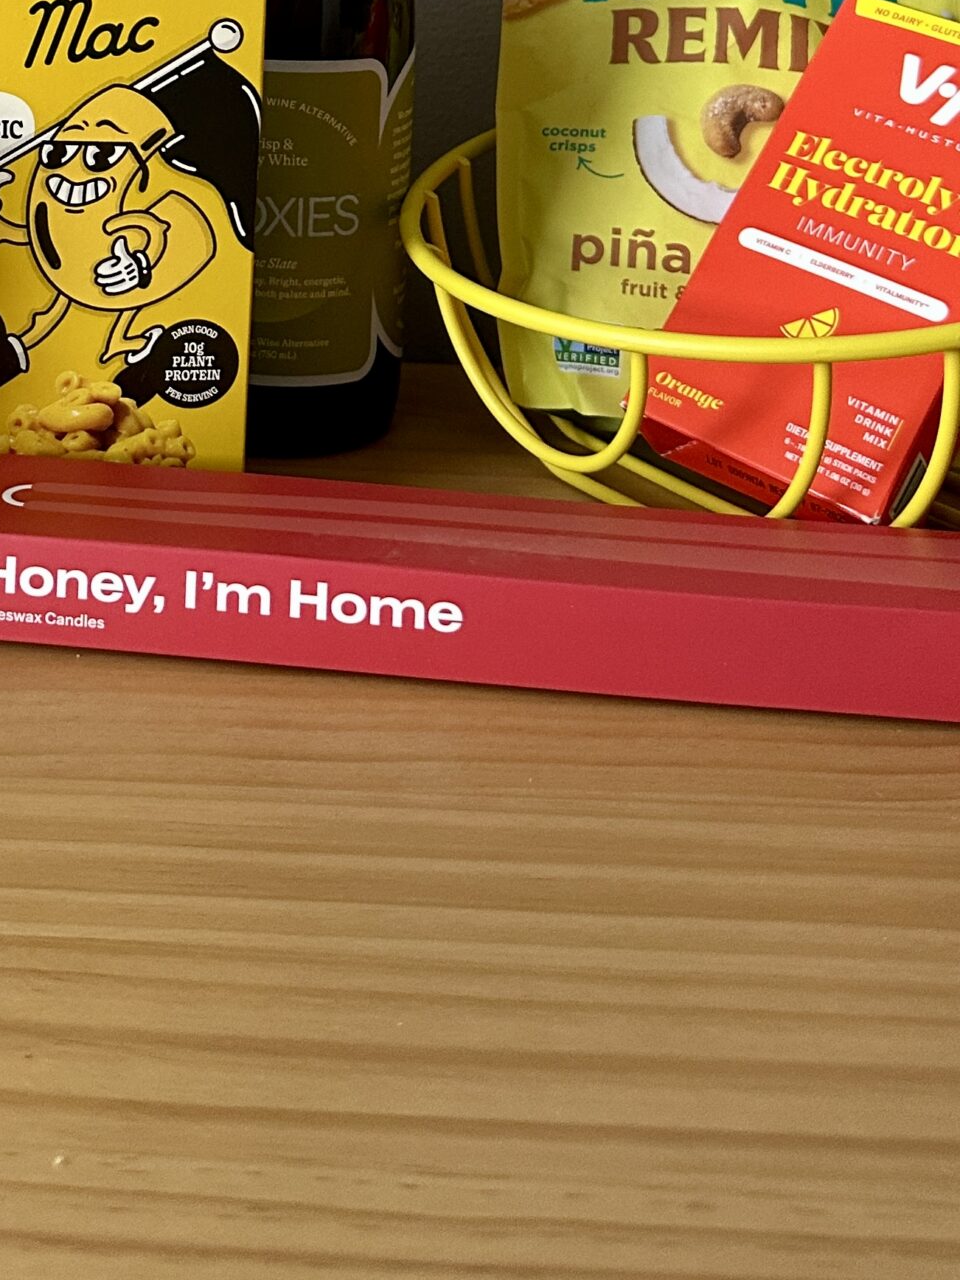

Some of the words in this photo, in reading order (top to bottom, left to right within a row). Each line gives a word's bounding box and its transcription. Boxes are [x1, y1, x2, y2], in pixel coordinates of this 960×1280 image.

[875, 7, 891, 18] NO
[891, 9, 924, 28] DAIRY
[609, 7, 830, 73] REMI
[266, 97, 296, 109] WINE
[298, 103, 359, 147] ALTERNATIVE
[542, 126, 606, 138] coconut
[283, 138, 294, 151] &
[549, 139, 596, 154] crisps
[268, 154, 309, 167] White
[571, 227, 692, 275] piña
[796, 216, 916, 271] IMMUNITY
[268, 258, 298, 270] Slate
[756, 237, 785, 254] VITAMIN
[810, 258, 855, 280] ELDERBERRY
[621, 279, 667, 299] fruit
[171, 325, 195, 340] DARN
[195, 325, 219, 339] GOOD
[183, 342, 205, 356] 10g
[557, 352, 617, 366] VERIFIED
[172, 355, 215, 368] PLANT
[164, 369, 221, 381] PROTEIN
[165, 386, 183, 401] PER
[182, 386, 219, 403] SERVING
[648, 387, 683, 408] FLAVOR
[655, 371, 724, 410] Orange
[847, 395, 900, 426] VITAMIN
[854, 414, 894, 437] DRINK
[862, 431, 889, 450] MIX
[824, 439, 885, 472] SUPPLEMENT
[832, 458, 853, 474] STICK
[853, 468, 877, 484] PACKS
[185, 570, 271, 616] I'm
[289, 579, 464, 634] Home
[45, 611, 105, 629] Candles
